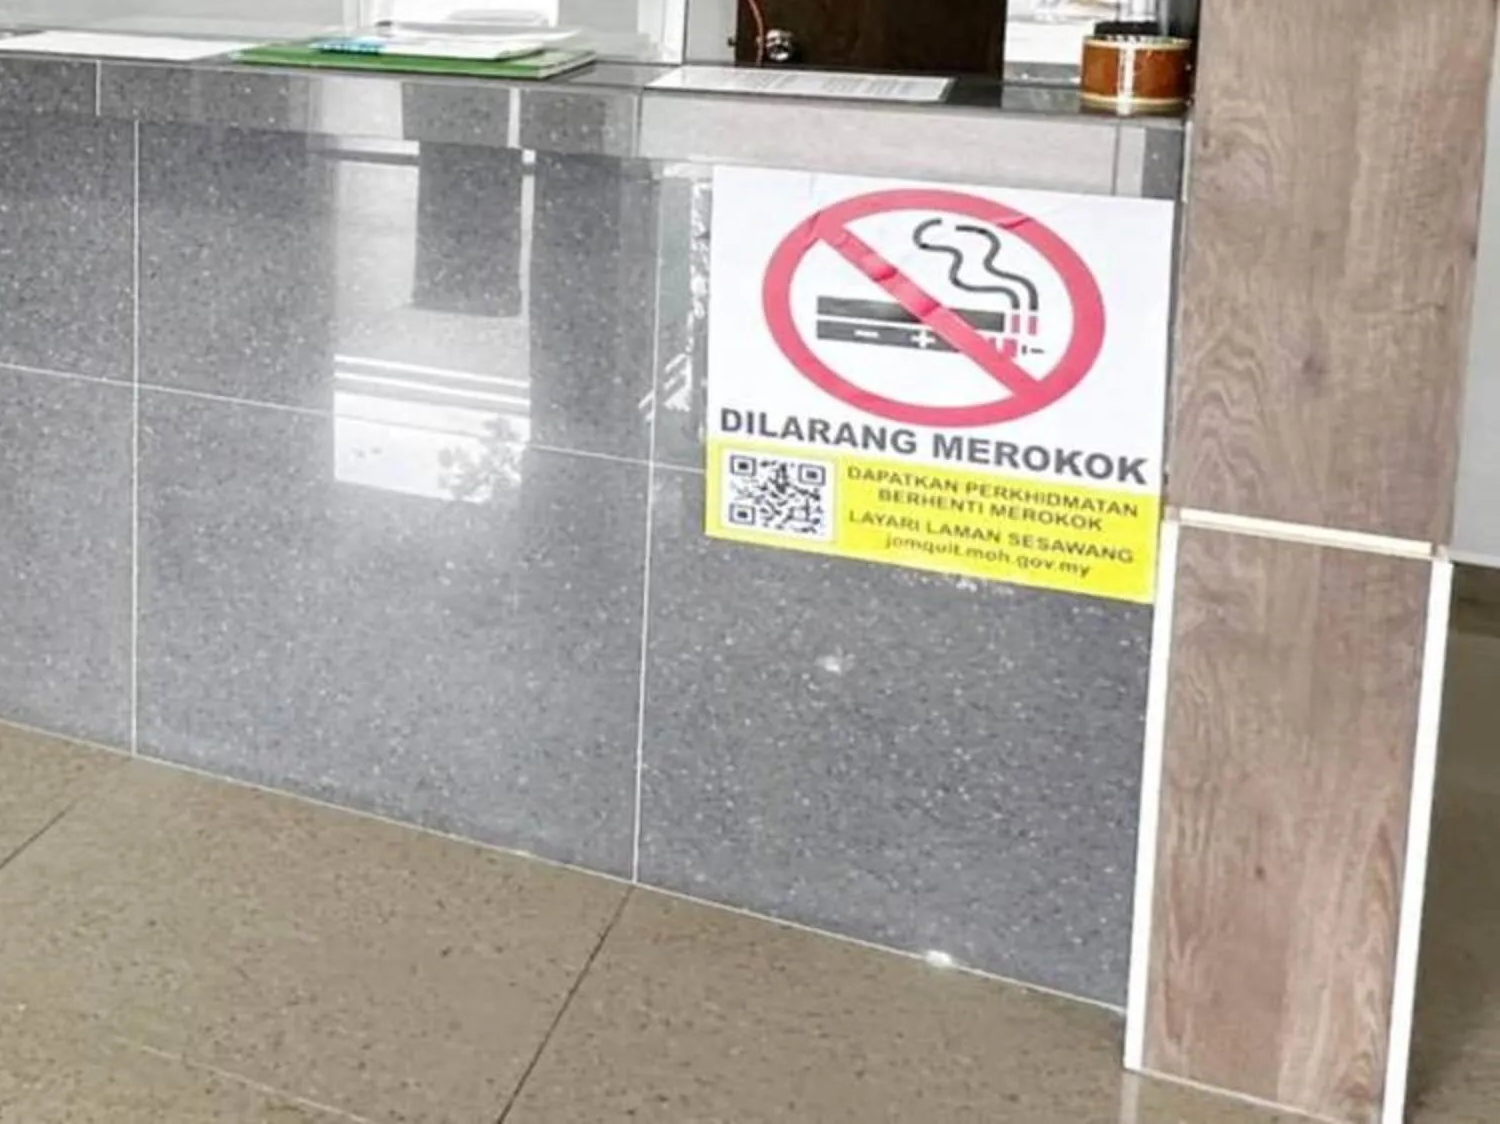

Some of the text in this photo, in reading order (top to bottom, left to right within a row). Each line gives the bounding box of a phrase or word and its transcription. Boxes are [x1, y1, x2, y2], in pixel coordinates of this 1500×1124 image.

[721, 407, 1149, 486] DILARANG MEROKOK
[847, 465, 1138, 517] DAPATKAN PERKHIDMATAN
[878, 488, 1103, 532] BERHENTI MEROKOK
[849, 509, 1134, 564] LAYARI LAMAN SESAWANG
